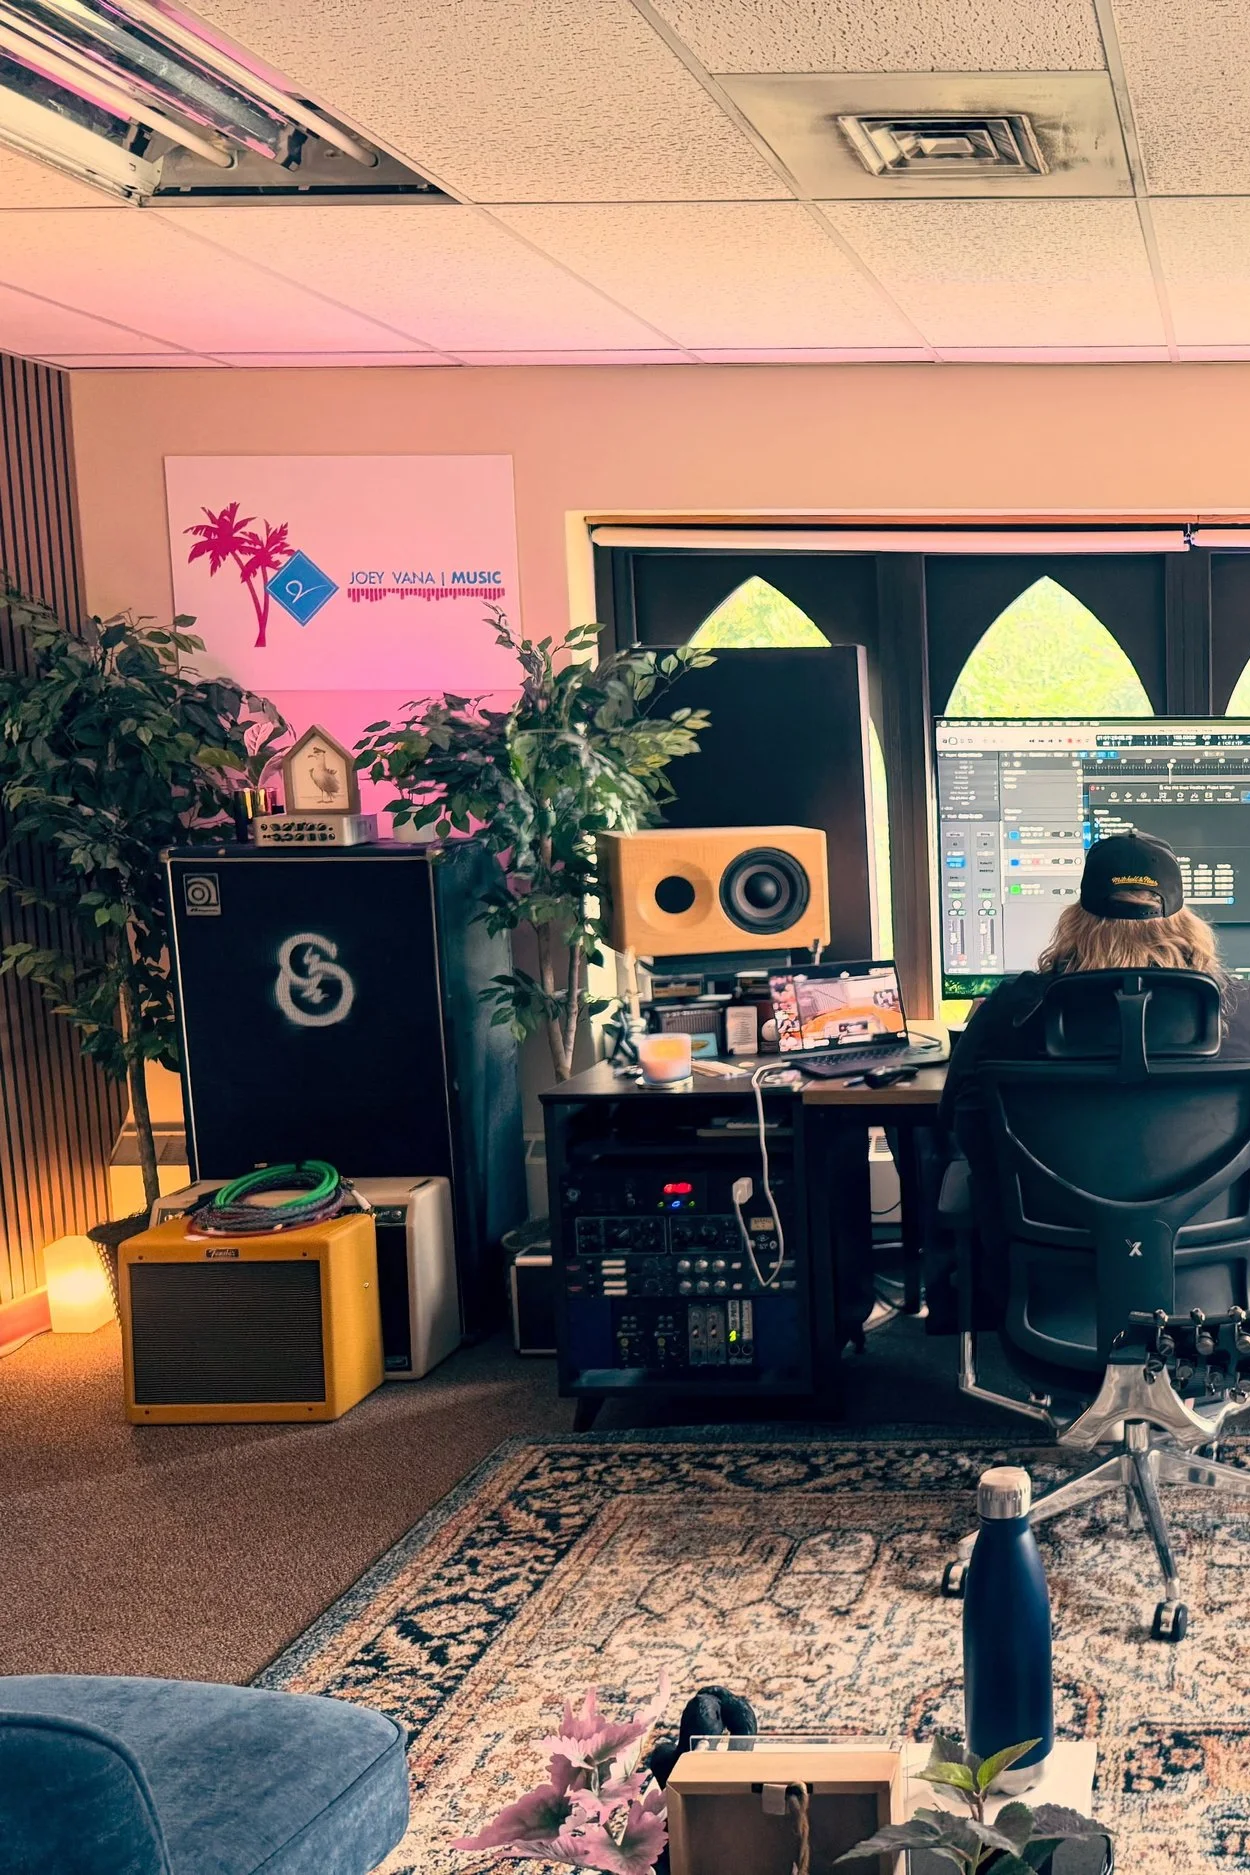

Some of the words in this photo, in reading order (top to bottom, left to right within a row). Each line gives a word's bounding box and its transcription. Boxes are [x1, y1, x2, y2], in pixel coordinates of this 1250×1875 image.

[349, 571, 385, 585] JOEY
[392, 571, 436, 585] VANA
[451, 571, 502, 585] MUSIC
